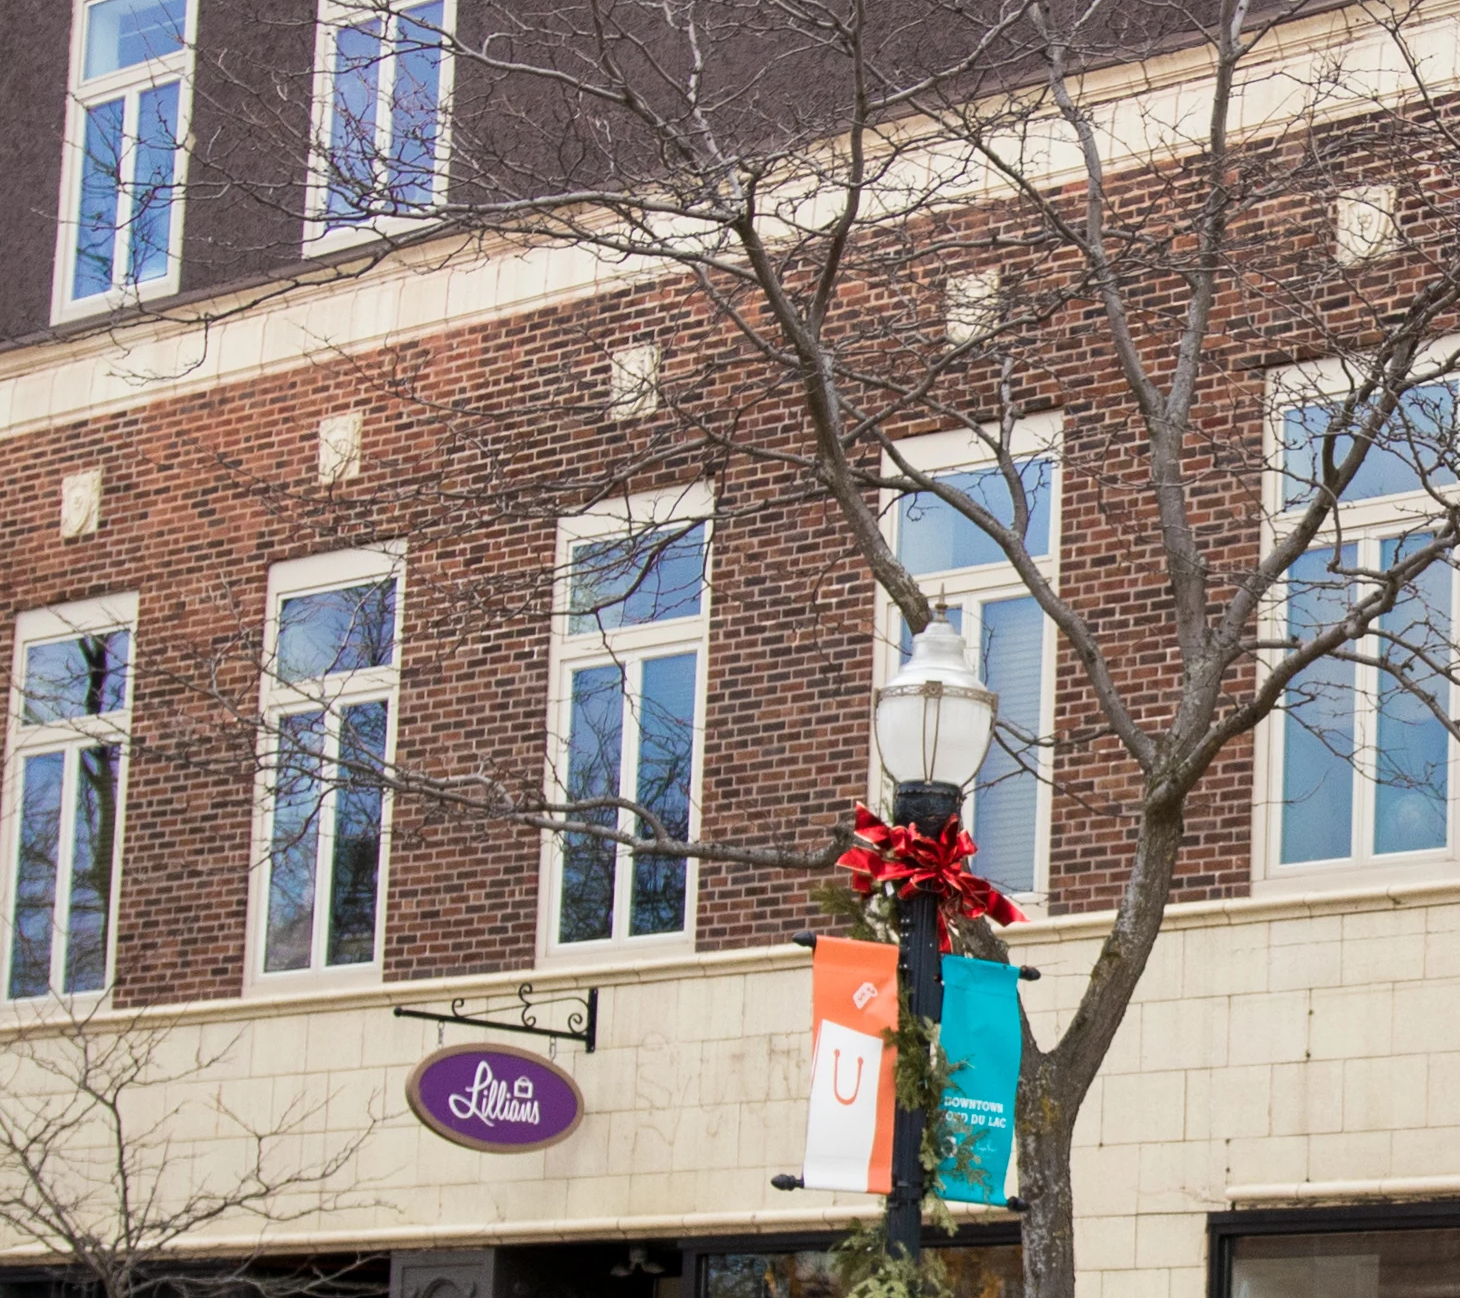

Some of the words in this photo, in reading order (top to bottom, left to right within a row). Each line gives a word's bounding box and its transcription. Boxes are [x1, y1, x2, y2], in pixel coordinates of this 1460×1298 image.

[448, 1059, 540, 1127] Lillians
[943, 1096, 1004, 1114] DOWNTOWN
[945, 1111, 969, 1123] OD
[971, 1113, 986, 1126] DU
[988, 1116, 1007, 1129] LAC
